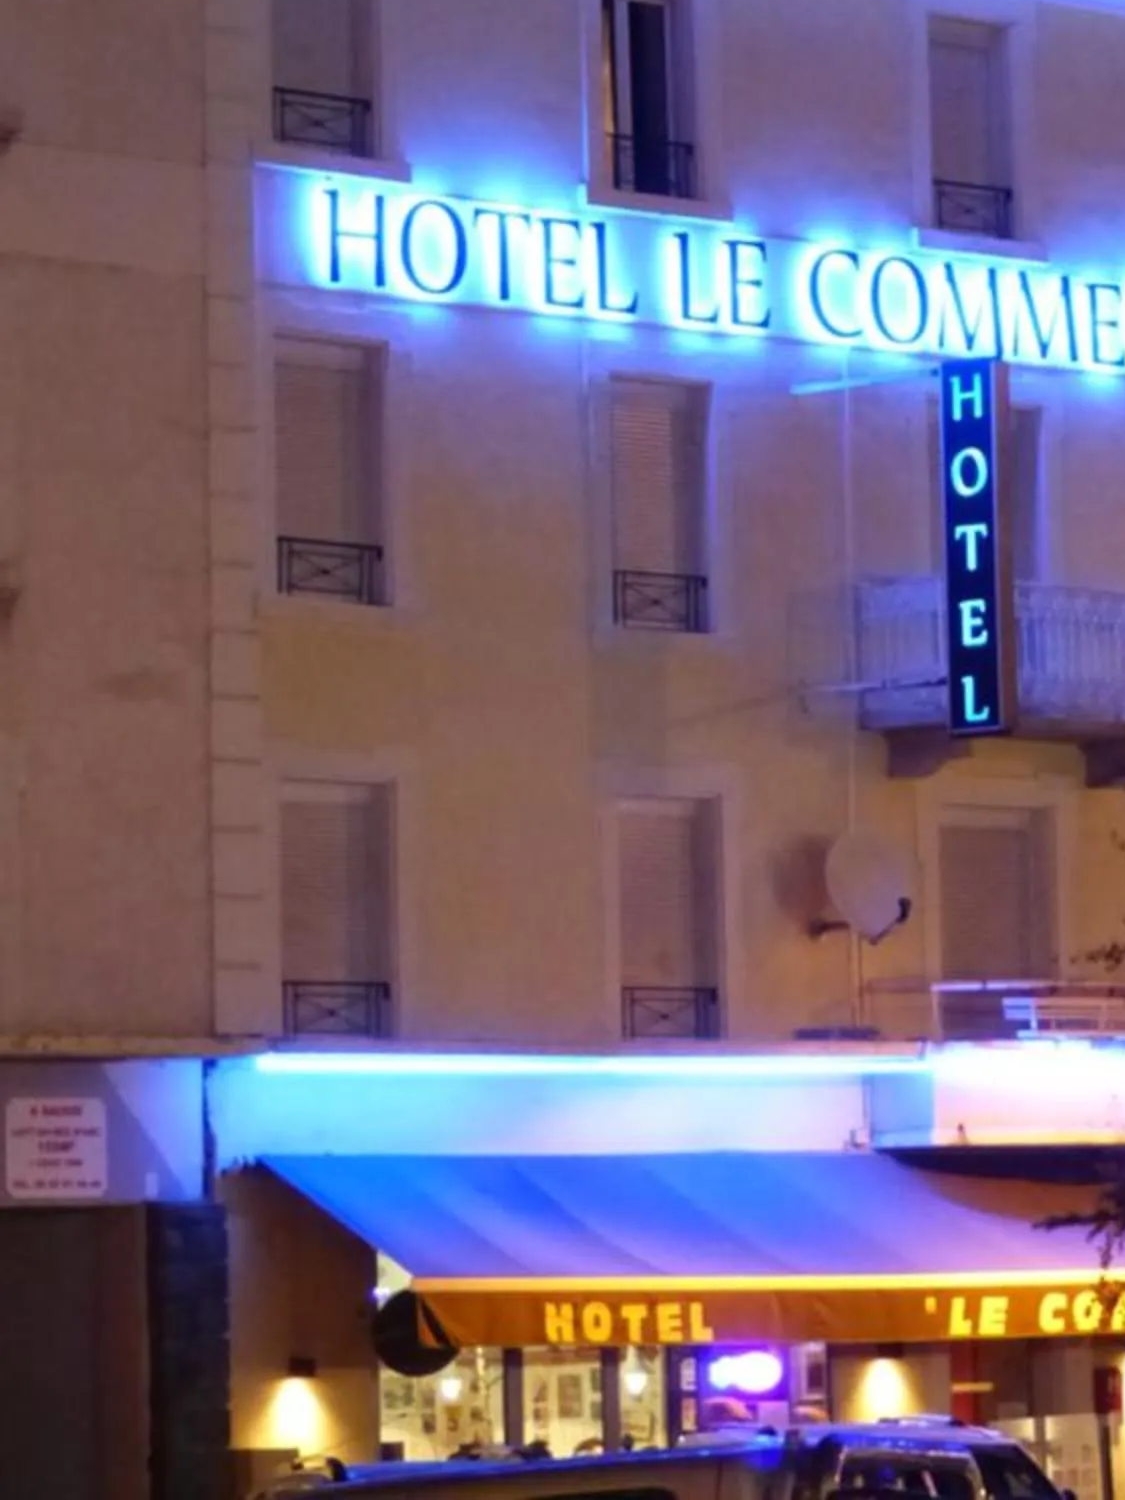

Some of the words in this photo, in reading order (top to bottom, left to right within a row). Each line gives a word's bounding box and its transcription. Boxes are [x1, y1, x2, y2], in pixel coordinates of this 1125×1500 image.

[323, 188, 639, 314] HOTEL
[673, 232, 771, 328] LE
[949, 372, 991, 724] HOTEL
[544, 1301, 714, 1343] HOTEL
